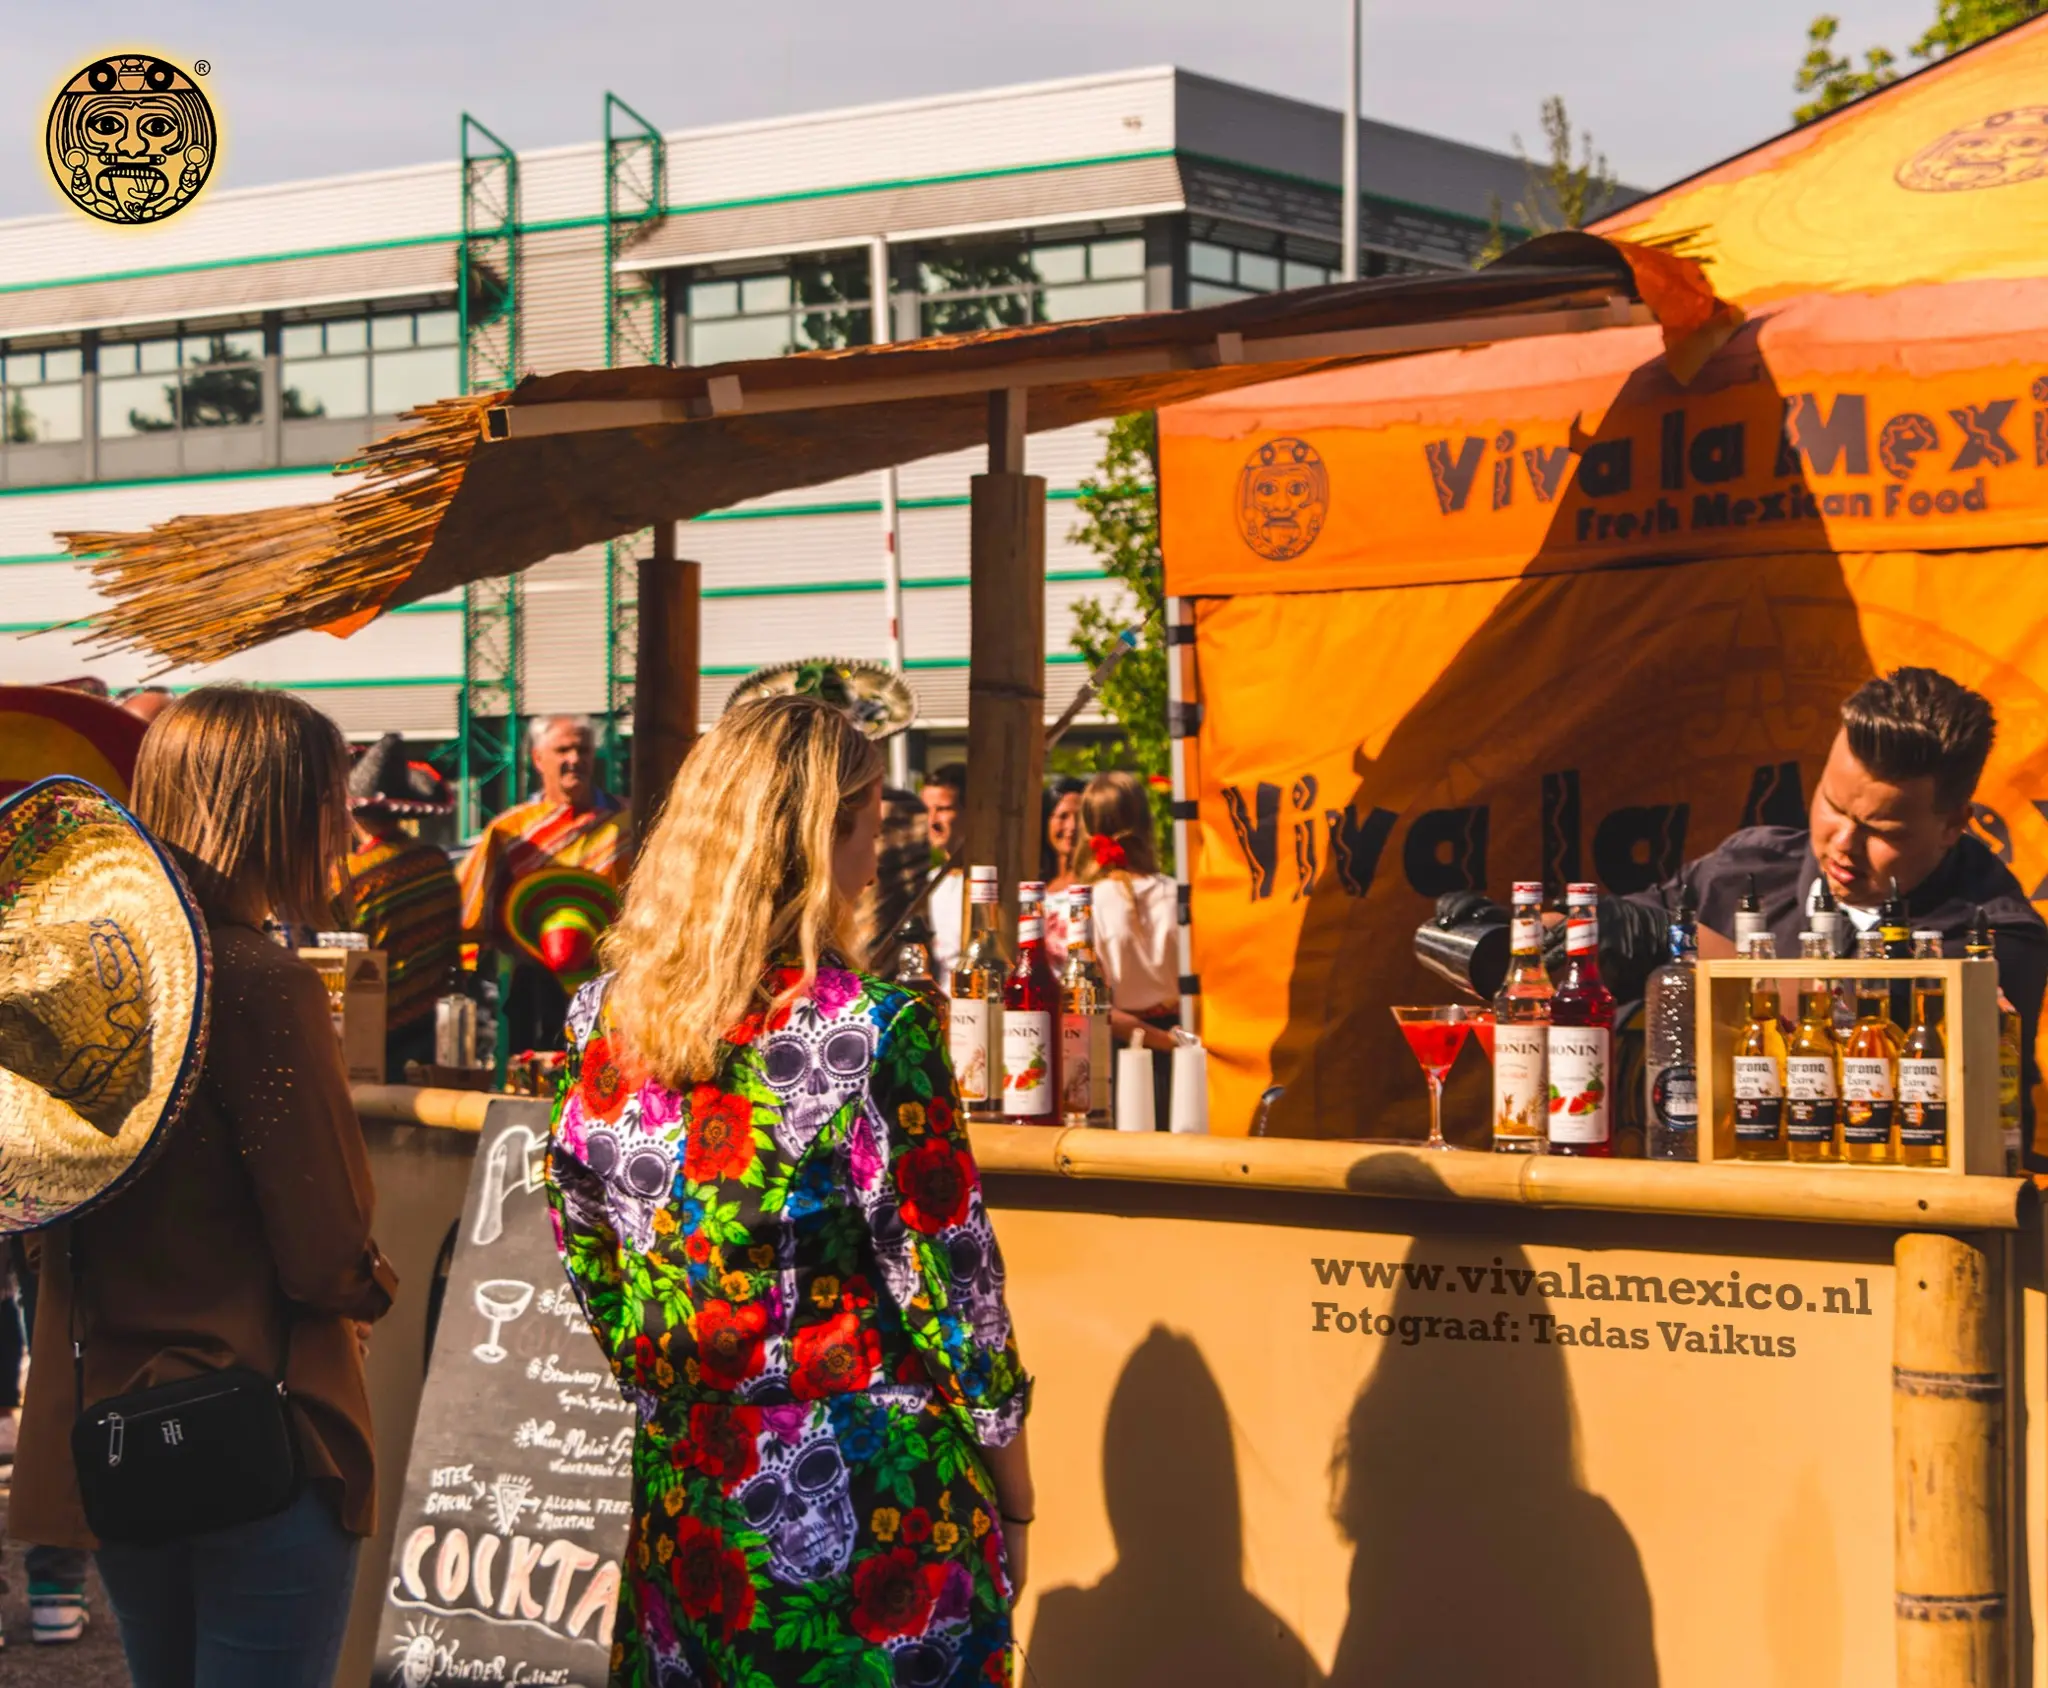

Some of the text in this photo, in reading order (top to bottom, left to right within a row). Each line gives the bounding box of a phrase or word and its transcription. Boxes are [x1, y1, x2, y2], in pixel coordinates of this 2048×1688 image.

[1423, 429, 1633, 516] Viva
[1661, 409, 1745, 490] la
[1576, 477, 1988, 542] Fresh Mexican Food
[1220, 774, 1490, 903] Viva
[1541, 769, 1691, 900] la
[1495, 1042, 1541, 1055] ONIN
